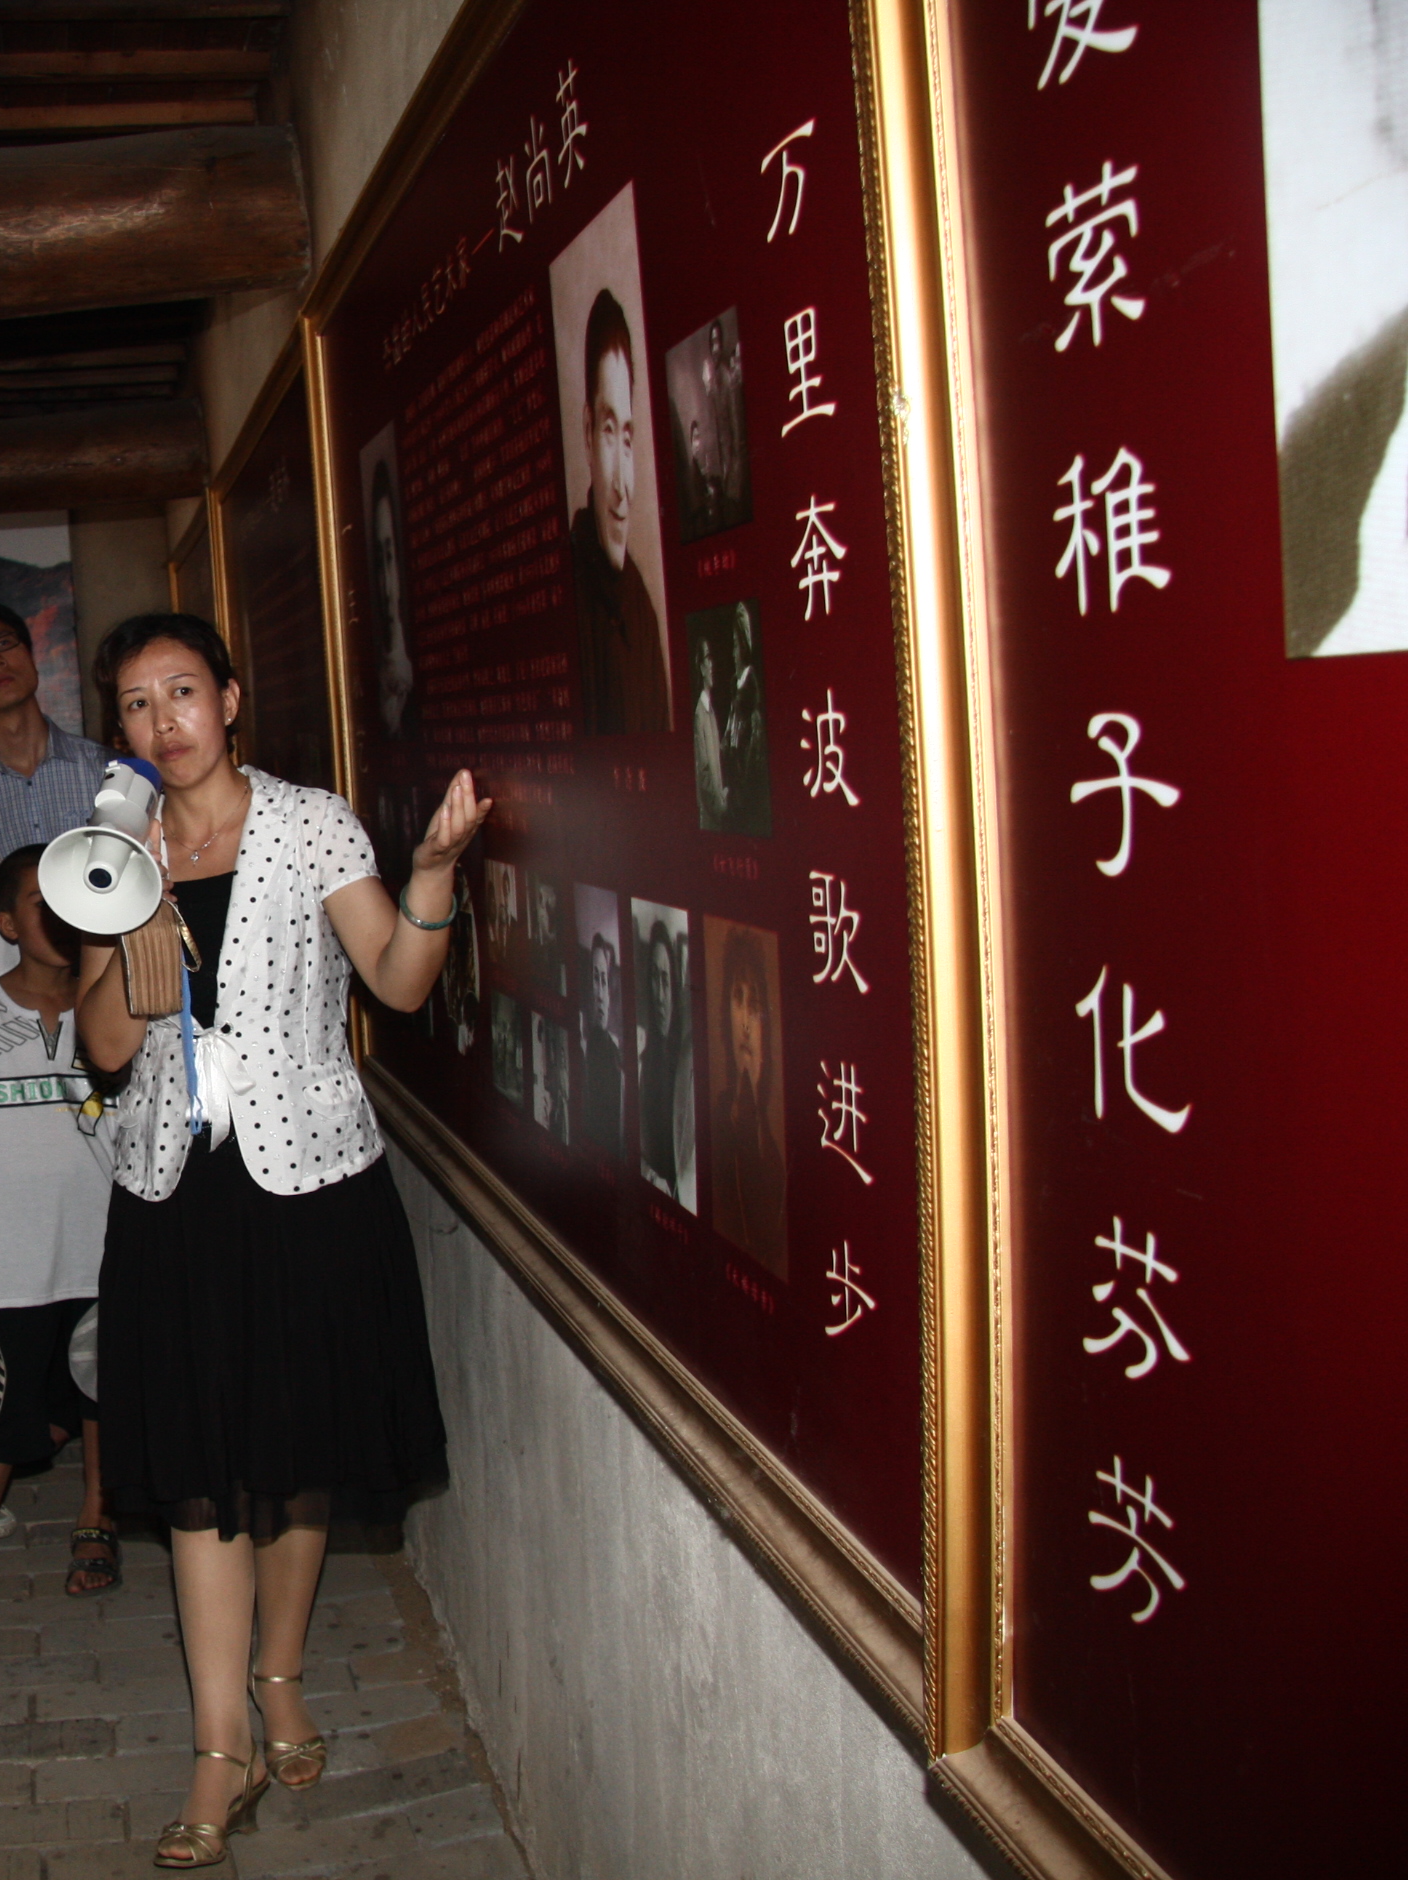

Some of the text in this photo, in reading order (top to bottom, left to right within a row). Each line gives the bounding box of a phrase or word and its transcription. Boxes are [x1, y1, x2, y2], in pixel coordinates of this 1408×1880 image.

[495, 58, 588, 253] 赵尚英
[760, 117, 876, 1337] 万里奔波歌进步
